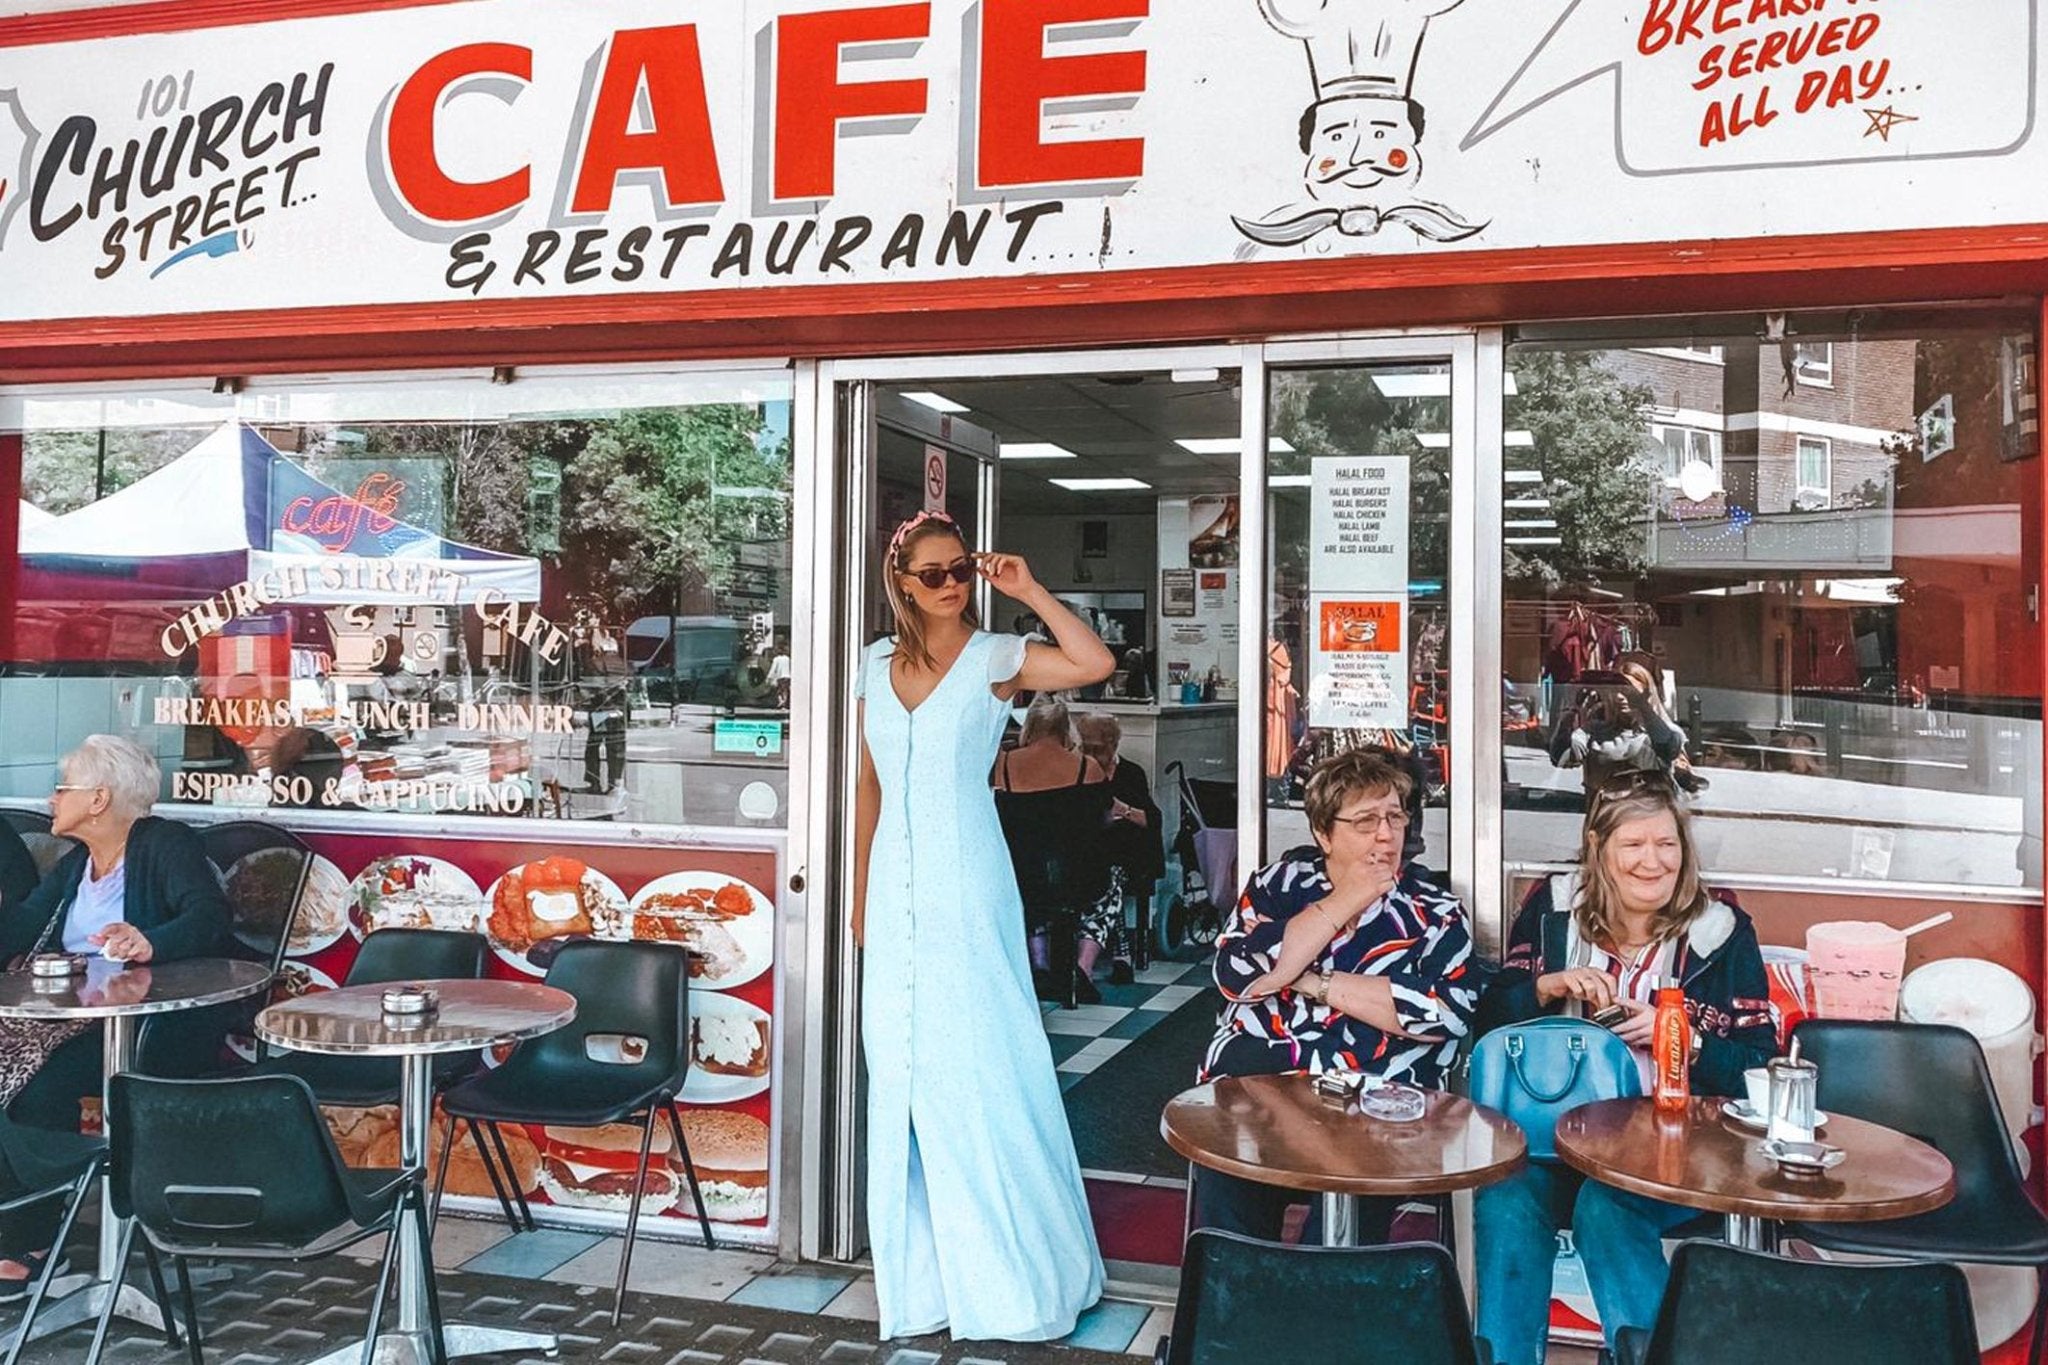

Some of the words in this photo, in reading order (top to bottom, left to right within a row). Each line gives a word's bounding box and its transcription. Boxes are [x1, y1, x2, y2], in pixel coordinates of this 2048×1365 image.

[1691, 13, 1880, 91] SERVED
[137, 70, 194, 120] 101
[367, 0, 1149, 240] CAFE
[1700, 86, 1779, 147] ALL
[30, 62, 334, 242] CHURCH
[445, 232, 497, 295] &
[1363, 468, 1385, 478] FOOD
[161, 563, 308, 657] CHURCH
[319, 556, 468, 605] STREET
[475, 586, 570, 666] CAFE
[457, 703, 574, 734] DINNER
[321, 776, 342, 806] &
[353, 778, 525, 814] CAPPUCINO
[1668, 1014, 1681, 1081] Lucozade
